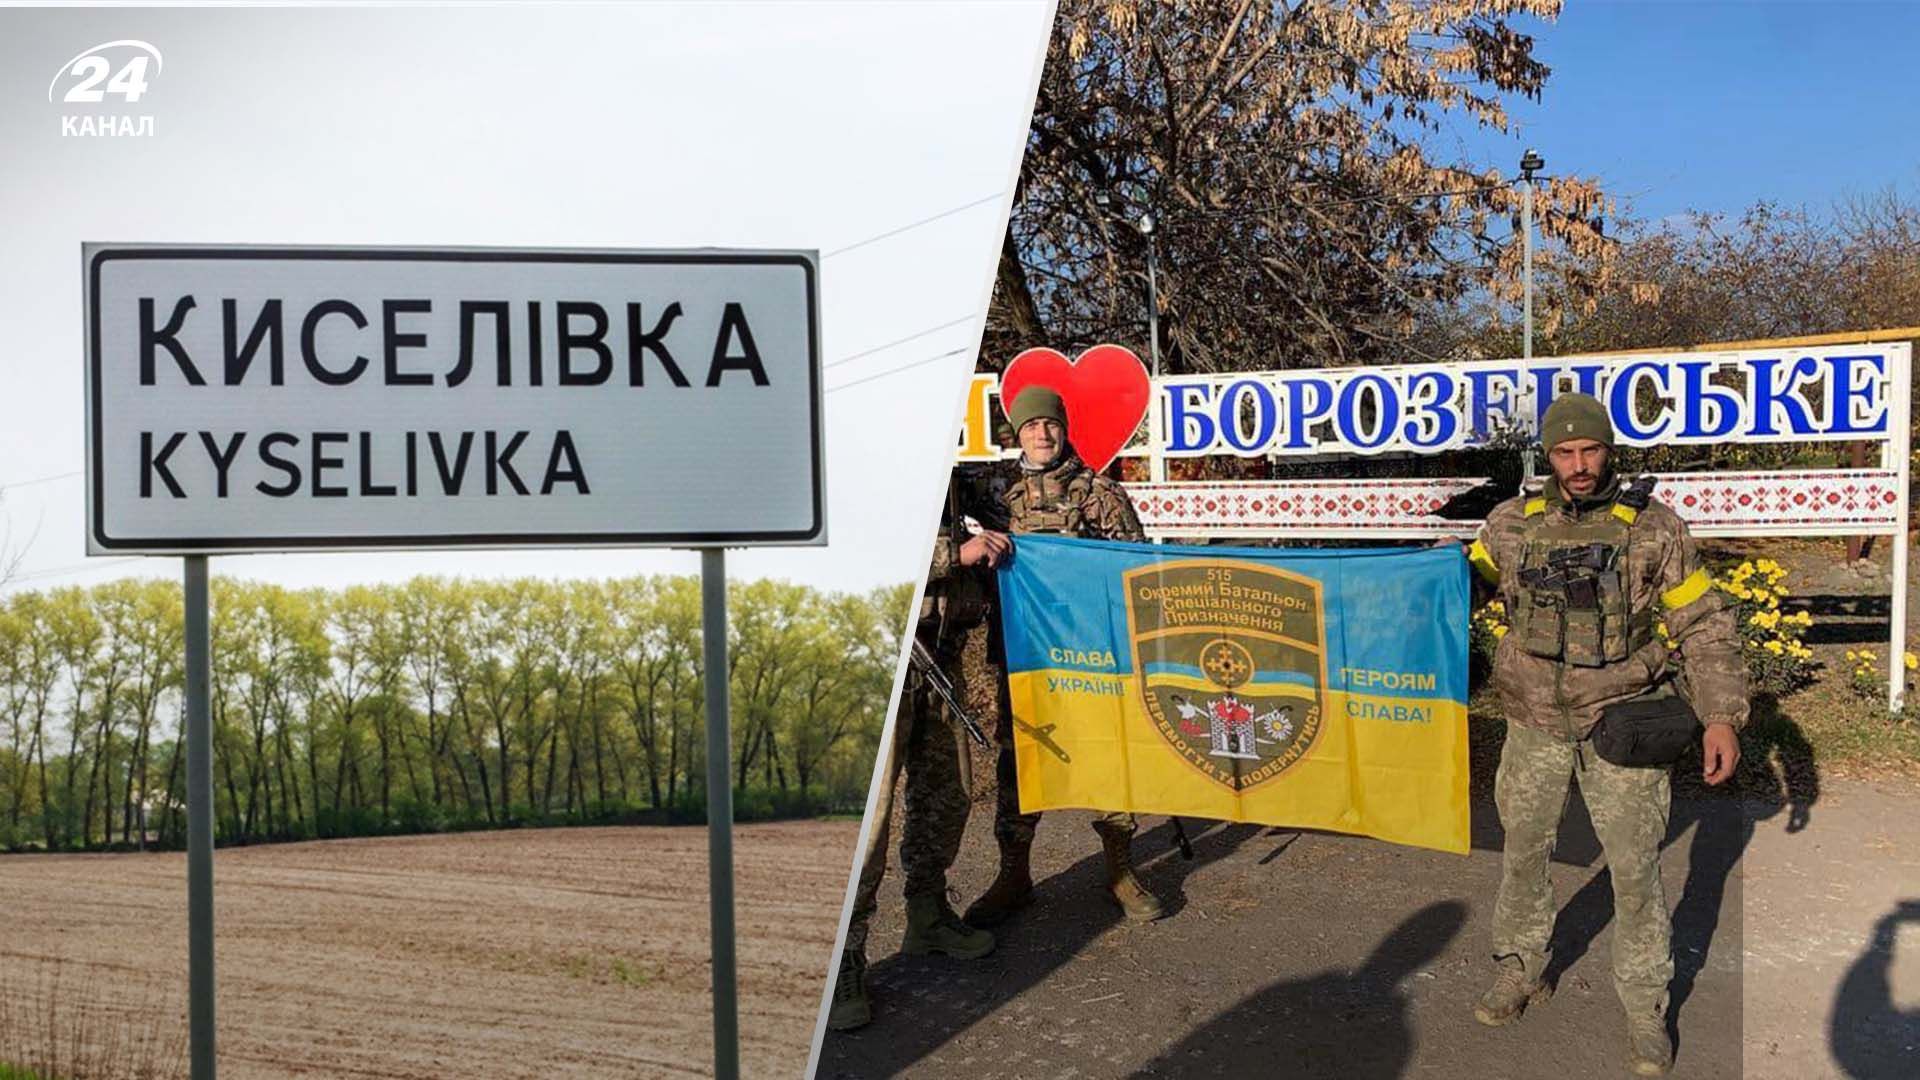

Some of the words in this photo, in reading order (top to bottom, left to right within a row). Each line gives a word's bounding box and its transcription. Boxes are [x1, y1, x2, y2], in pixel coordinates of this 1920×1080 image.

[138, 295, 770, 388] КИСЕЛІВКА
[140, 430, 591, 498] KYSELIVKA
[1207, 568, 1232, 581] 515
[1139, 582, 1214, 601] Окремий
[1219, 582, 1307, 611] Батальон
[1162, 598, 1283, 618] Спеціального
[1164, 610, 1284, 632] Призначення
[1050, 647, 1116, 667] СЛАВА
[1340, 667, 1436, 691] ГЕРОЯМ
[1346, 700, 1432, 723] СЛАВА!
[1145, 690, 1216, 775] ПЕРЕМОГТИ
[1219, 769, 1236, 787] ТА
[1240, 705, 1320, 788] ПОВЕРНУТИСЬ
